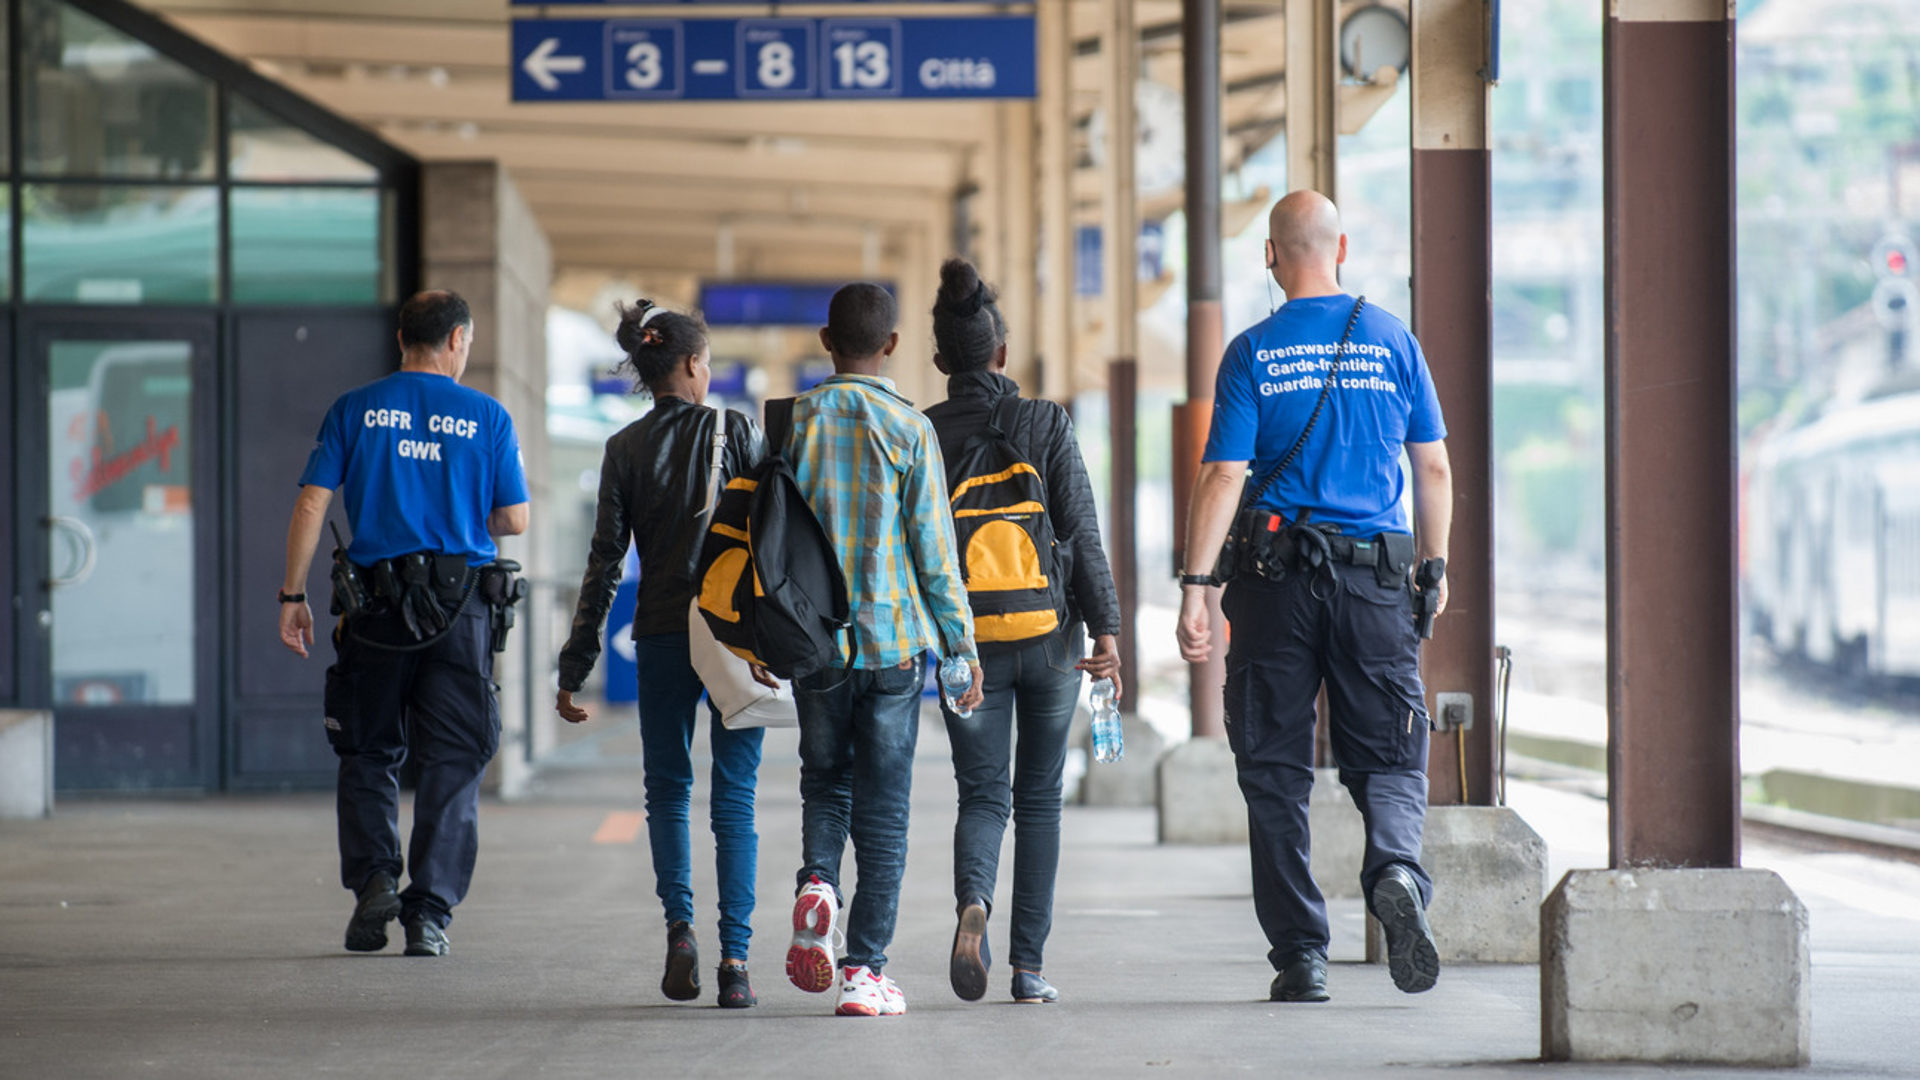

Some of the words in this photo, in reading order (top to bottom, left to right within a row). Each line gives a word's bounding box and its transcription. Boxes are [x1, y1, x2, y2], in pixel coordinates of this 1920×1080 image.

[626, 42, 662, 89] 3
[757, 41, 795, 88] 8
[834, 41, 889, 88] 13
[1256, 342, 1391, 362] Grenzwachtkorps
[1259, 377, 1322, 396] Guardia
[1341, 376, 1397, 392] confine
[364, 409, 412, 430] CGFR
[428, 415, 478, 439] CGCF
[398, 439, 442, 461] GWK
